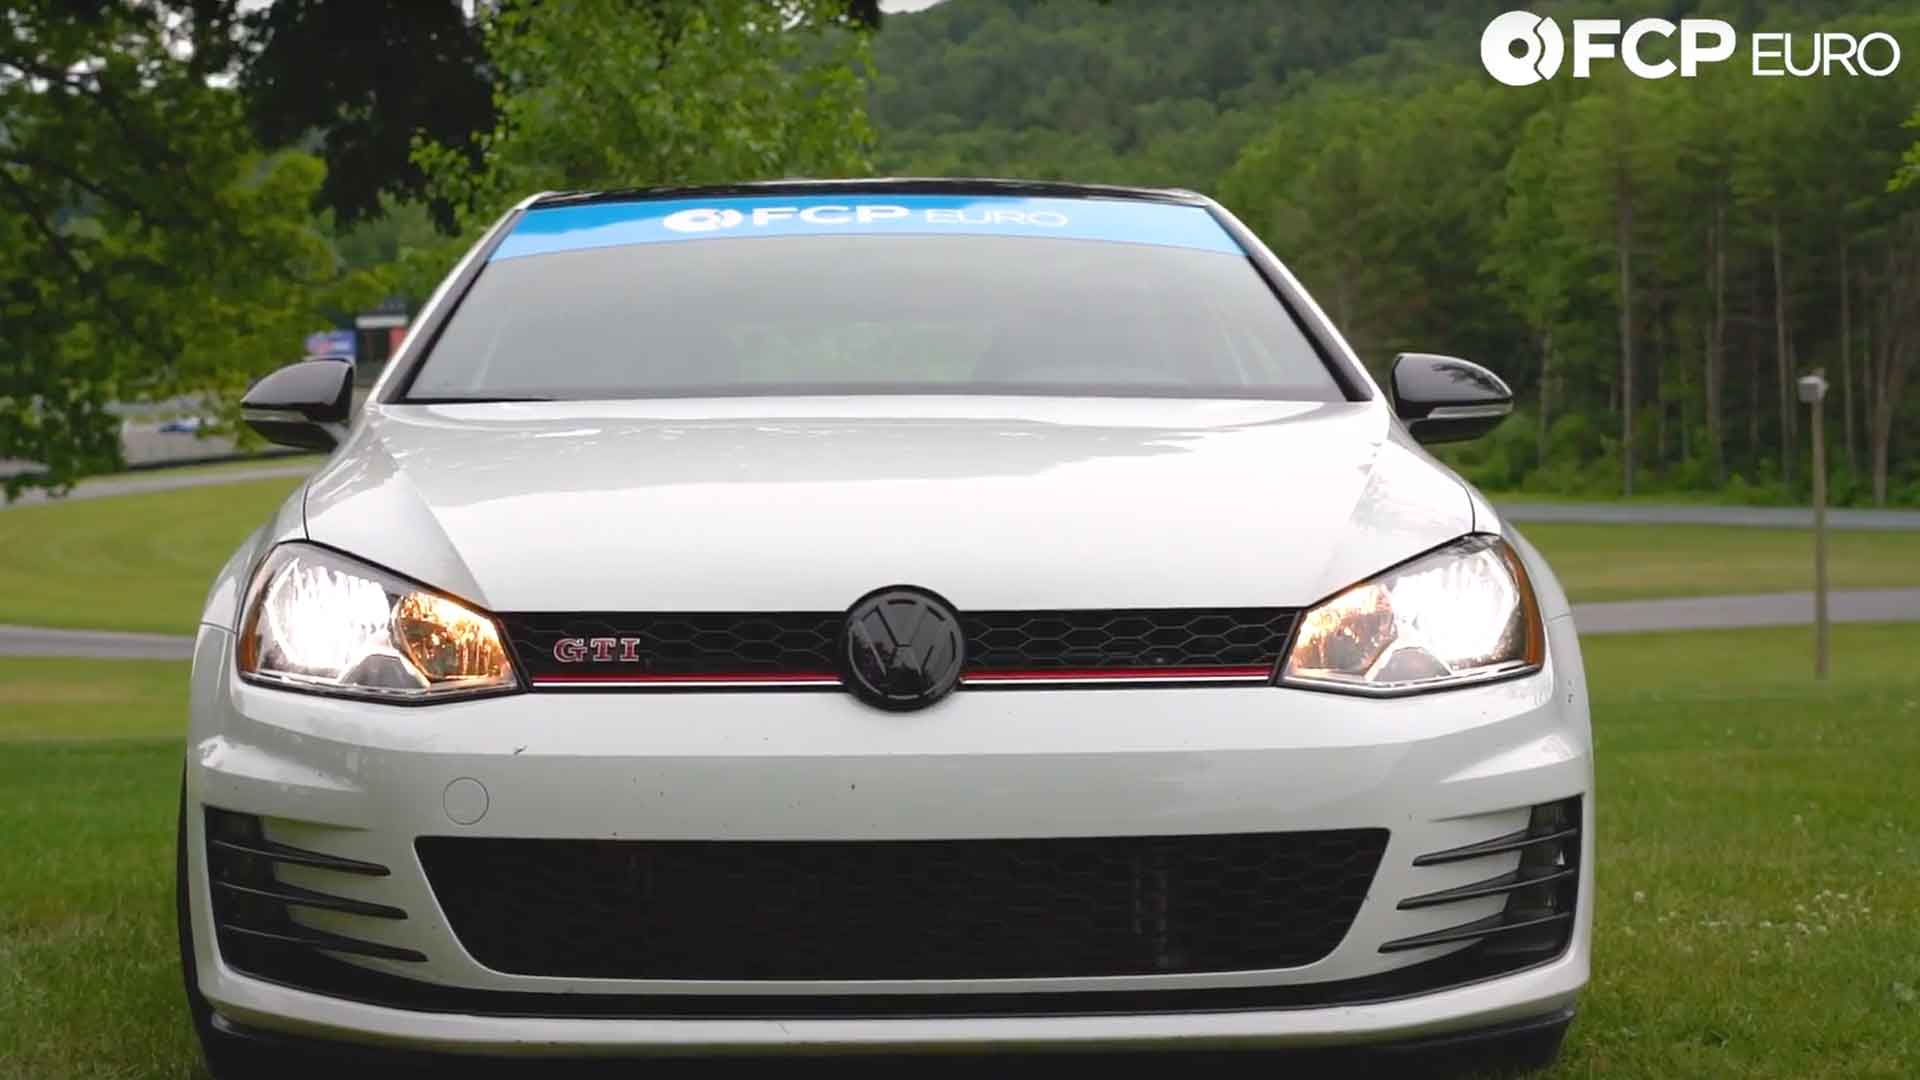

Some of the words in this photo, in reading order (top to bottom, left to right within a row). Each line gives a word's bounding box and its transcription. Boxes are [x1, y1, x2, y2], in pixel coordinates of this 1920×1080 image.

[753, 205, 911, 226] FCP
[924, 208, 1069, 228] EURO
[553, 637, 641, 663] GTI
